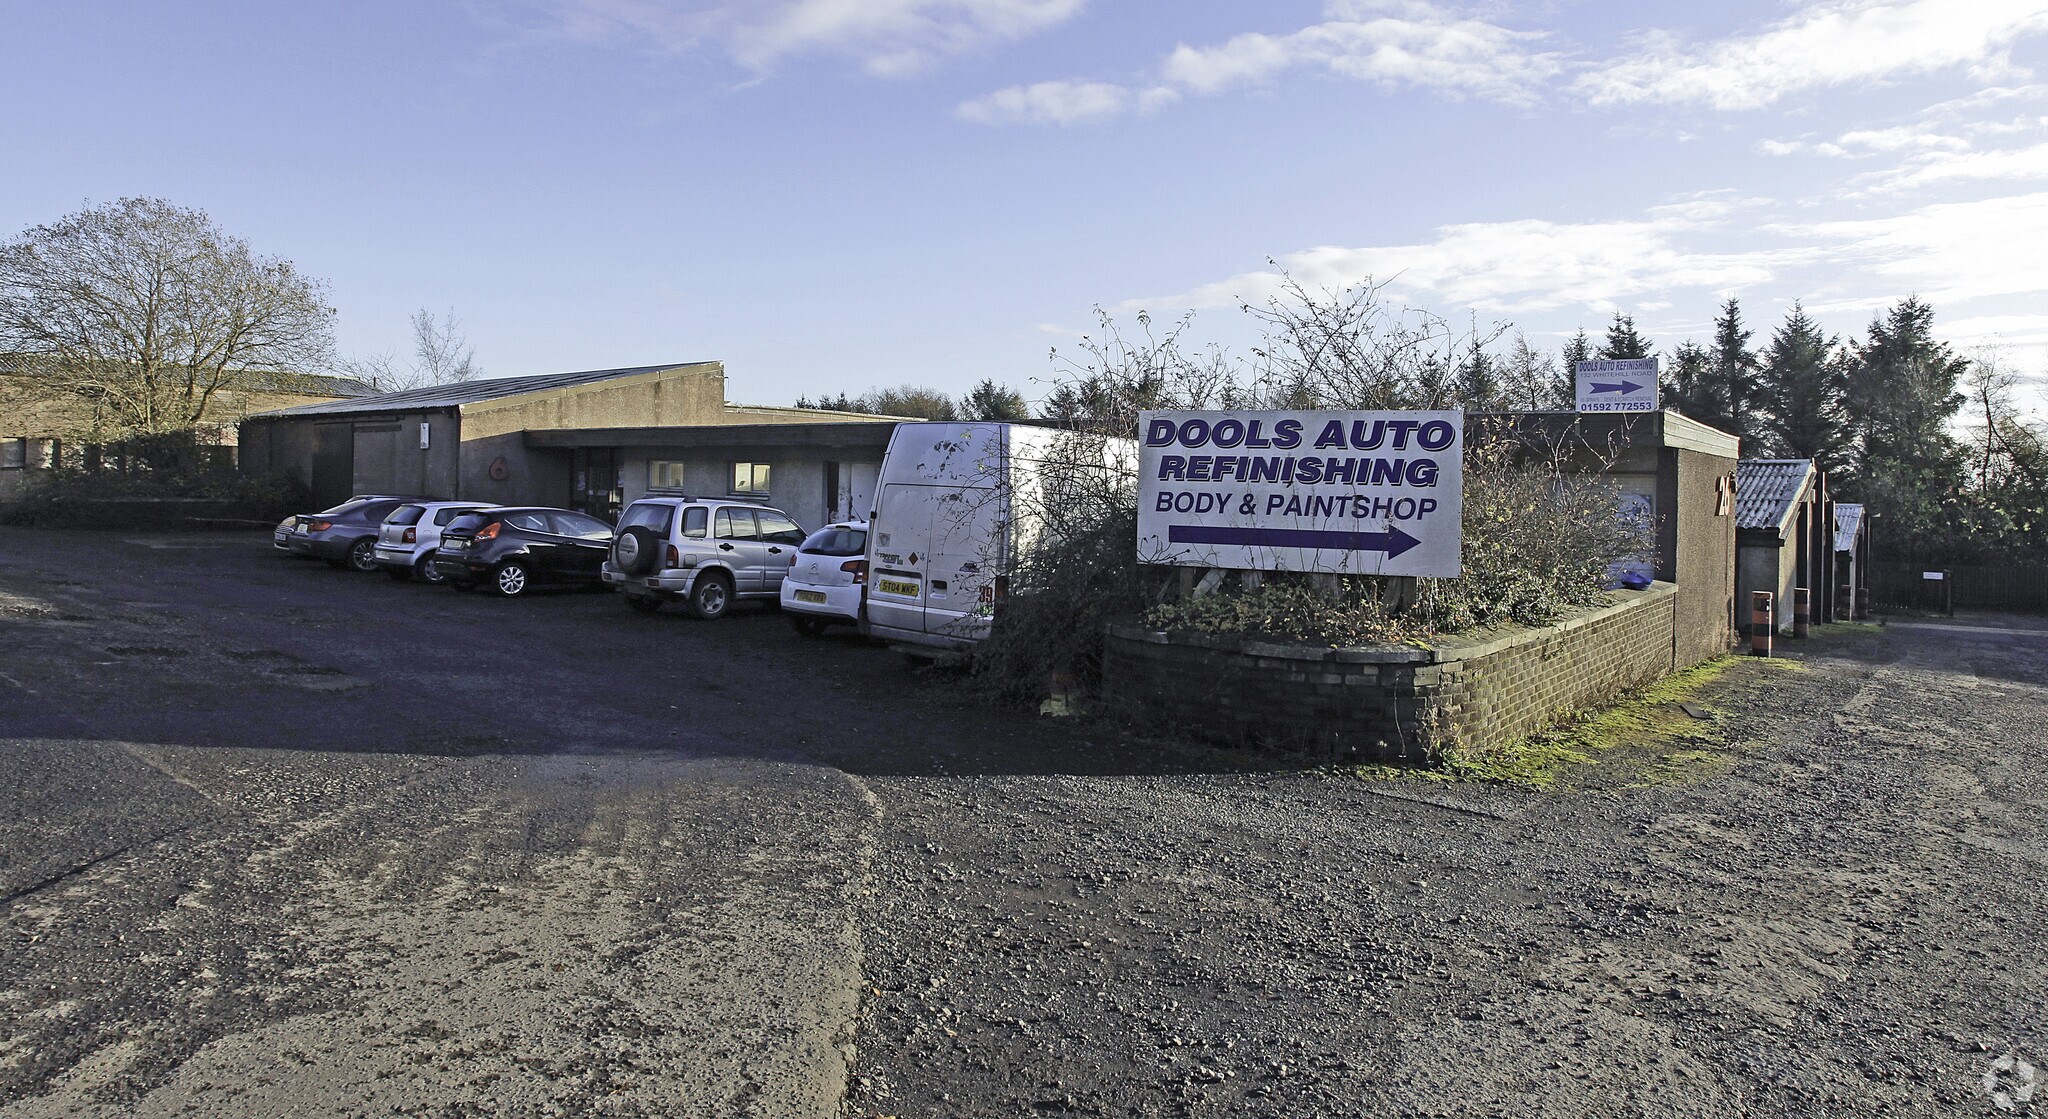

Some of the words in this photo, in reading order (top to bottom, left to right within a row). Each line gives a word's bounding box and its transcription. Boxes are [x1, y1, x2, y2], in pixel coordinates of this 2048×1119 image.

[1579, 362, 1598, 372] DOOLS
[1599, 361, 1615, 371] AUTO
[1616, 360, 1653, 371] REFINISHING
[1581, 403, 1611, 411] 01592
[1614, 402, 1652, 410] 772553
[1147, 419, 1303, 449] DOOLS
[1314, 420, 1456, 451] AUTO
[1158, 455, 1440, 487] REFINISHING
[1155, 492, 1233, 514] BODY
[1239, 493, 1257, 515] &
[1265, 494, 1437, 521] PAINTSHOP
[882, 581, 900, 592] ST04
[901, 584, 916, 594] WKF
